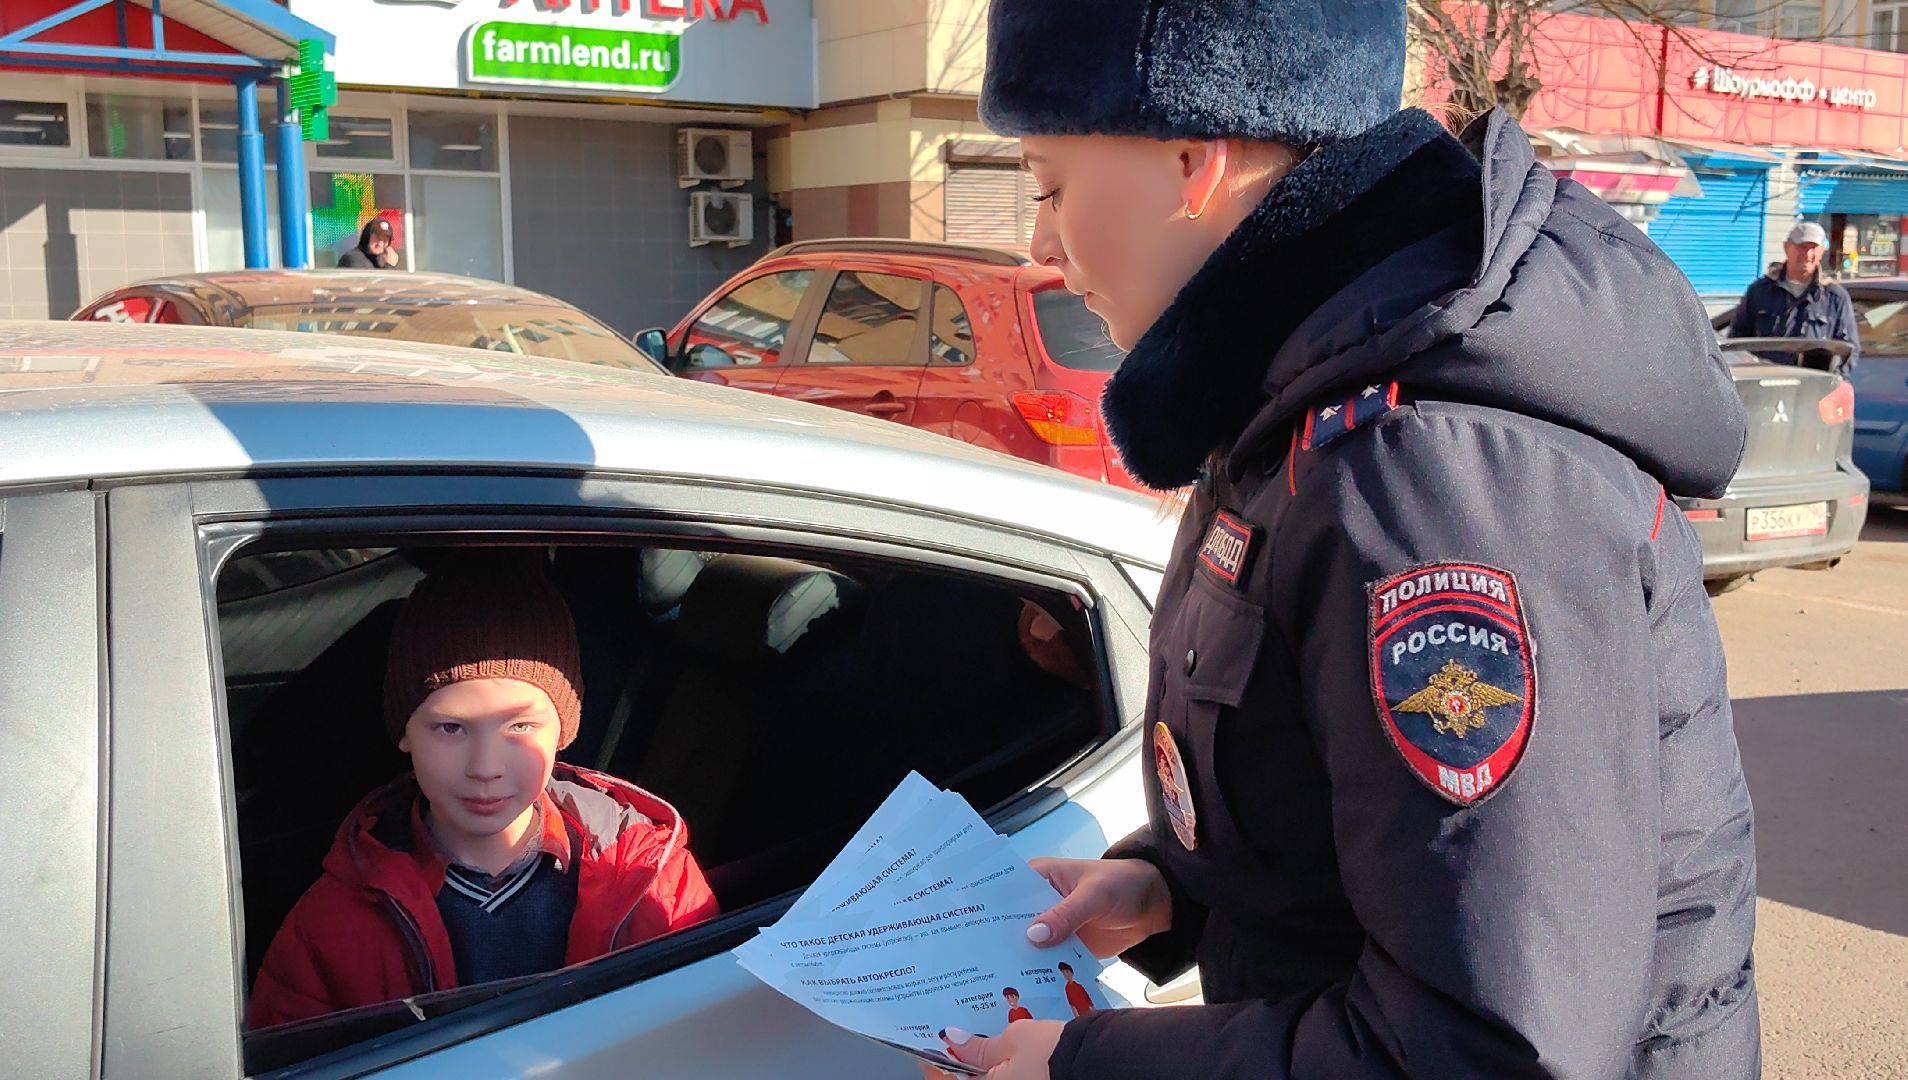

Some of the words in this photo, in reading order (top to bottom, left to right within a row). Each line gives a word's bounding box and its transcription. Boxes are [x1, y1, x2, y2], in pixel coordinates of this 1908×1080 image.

[482, 31, 671, 72] farmlend.ru
[1831, 86, 1877, 110] центр
[1380, 572, 1506, 613] ПОЛИЦИЯ
[1391, 622, 1510, 664] РОССИЯ
[1437, 763, 1492, 798] МВД
[881, 848, 917, 878] СИСТЕМА?
[913, 876, 953, 900] СИСТЕМА?
[780, 941, 798, 949] ЧТО
[799, 937, 826, 947] ТАКОЕ
[828, 930, 866, 945] ДЕТСКАЯ
[867, 913, 941, 937] УДЕРЖИВАЮЩАЯ
[942, 903, 985, 919] СИСТЕМА?
[819, 977, 856, 987] ВЫБРАТЬ
[857, 965, 916, 983] АВТОКРЕСЛО?
[954, 998, 960, 1006] 3
[960, 991, 994, 1005] категория
[971, 1001, 990, 1012] 15-25
[990, 1000, 998, 1008] кг
